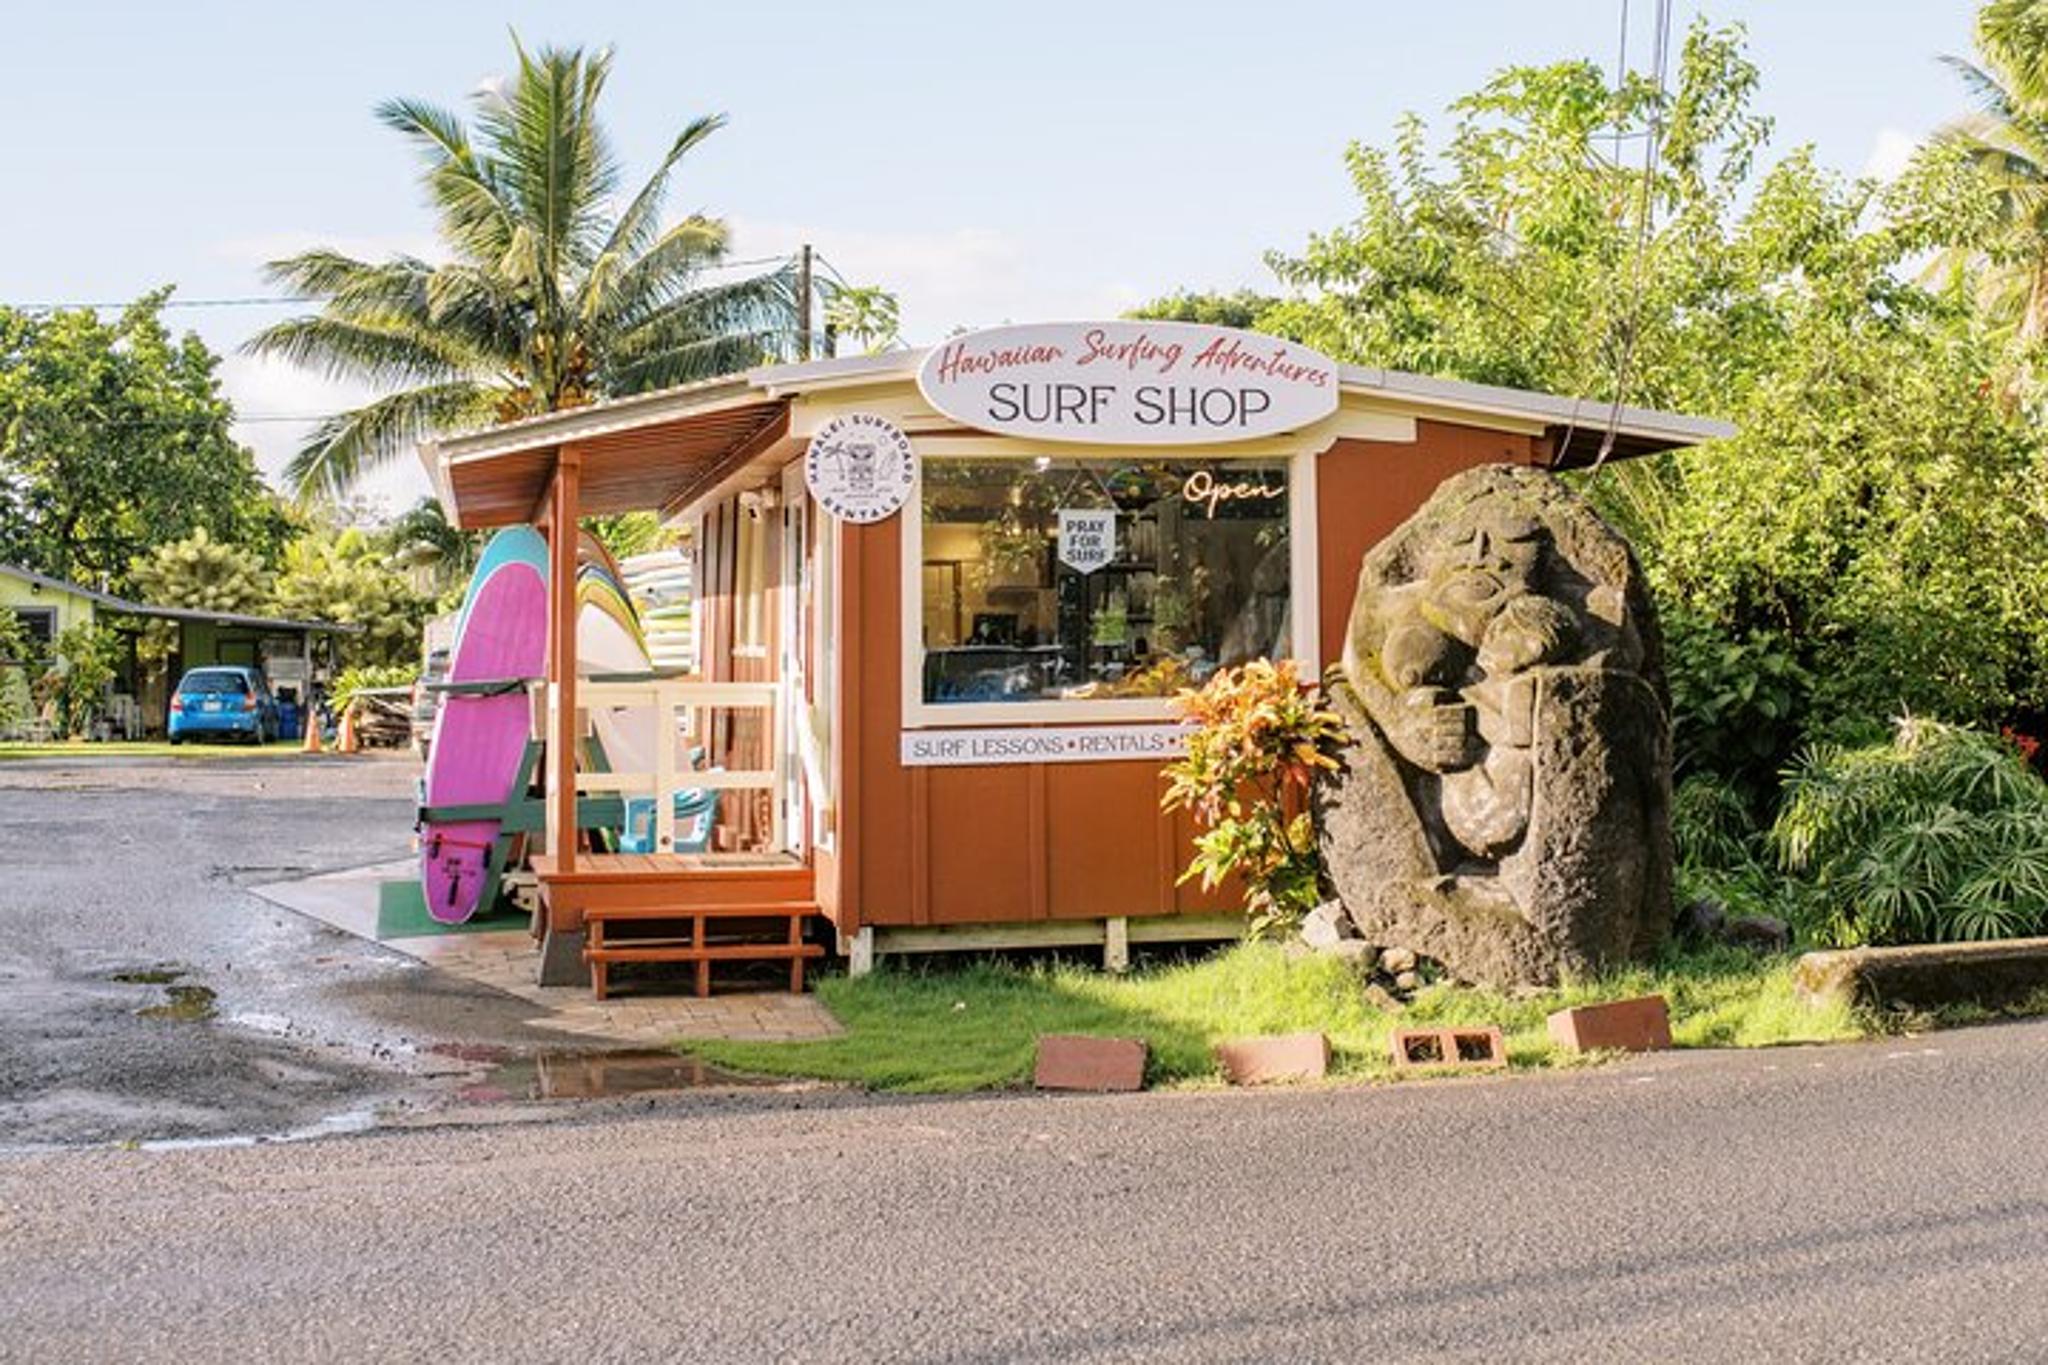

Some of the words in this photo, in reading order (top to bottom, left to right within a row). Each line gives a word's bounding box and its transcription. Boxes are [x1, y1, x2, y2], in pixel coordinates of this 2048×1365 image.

[938, 343, 1062, 384] Hawaiian
[1077, 329, 1182, 372] Surfing
[1191, 336, 1330, 387] Adventures
[988, 383, 1117, 424] SURF
[1134, 386, 1271, 426] SHOP
[810, 419, 846, 484] HANALEI
[853, 415, 913, 484] SURFBOARD
[1183, 471, 1284, 519] Open
[823, 497, 900, 518] RENTALS
[1066, 520, 1106, 532] PRAY
[1069, 534, 1101, 547] FOR
[1066, 548, 1107, 562] SURF
[914, 738, 966, 757] SURF
[972, 736, 1065, 757] LESSONS
[1079, 733, 1164, 752] RENTALS
